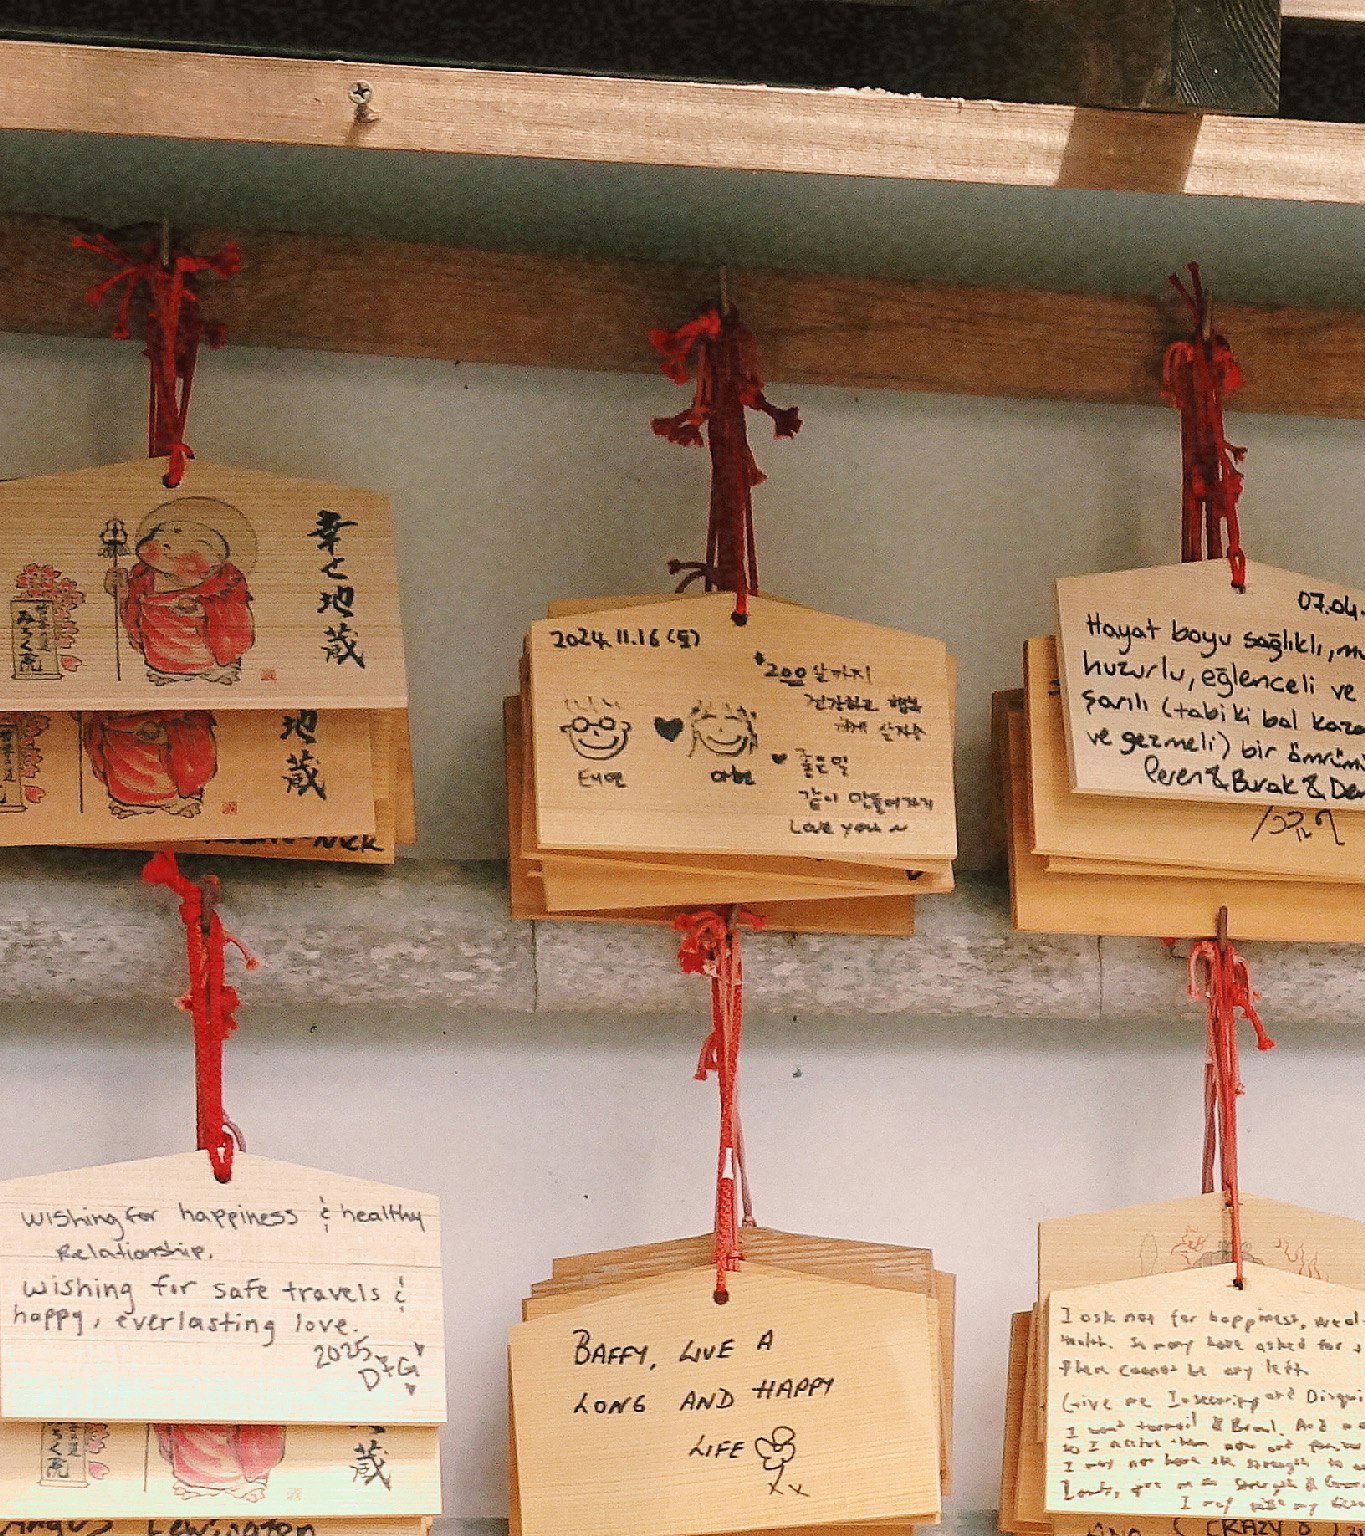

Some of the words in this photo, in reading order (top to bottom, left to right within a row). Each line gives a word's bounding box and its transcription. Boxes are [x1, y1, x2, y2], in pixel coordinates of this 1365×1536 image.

[1086, 612, 1161, 656] Hayat
[1171, 619, 1232, 659] boyu
[1330, 683, 1357, 702] ve
[178, 1202, 298, 1230] happiness
[340, 1203, 426, 1233] healthy
[22, 1275, 136, 1316] wishing
[150, 1273, 197, 1297] for
[213, 1277, 268, 1300] safe
[281, 1281, 381, 1303] travels
[115, 1310, 276, 1348] everlasting
[295, 1312, 359, 1336] love.
[678, 1338, 735, 1363] LIVE
[756, 1329, 774, 1351] A
[573, 1392, 646, 1415] LONG
[679, 1387, 735, 1412] AND
[751, 1376, 835, 1400] HAPPY
[688, 1434, 745, 1459] LIFE
